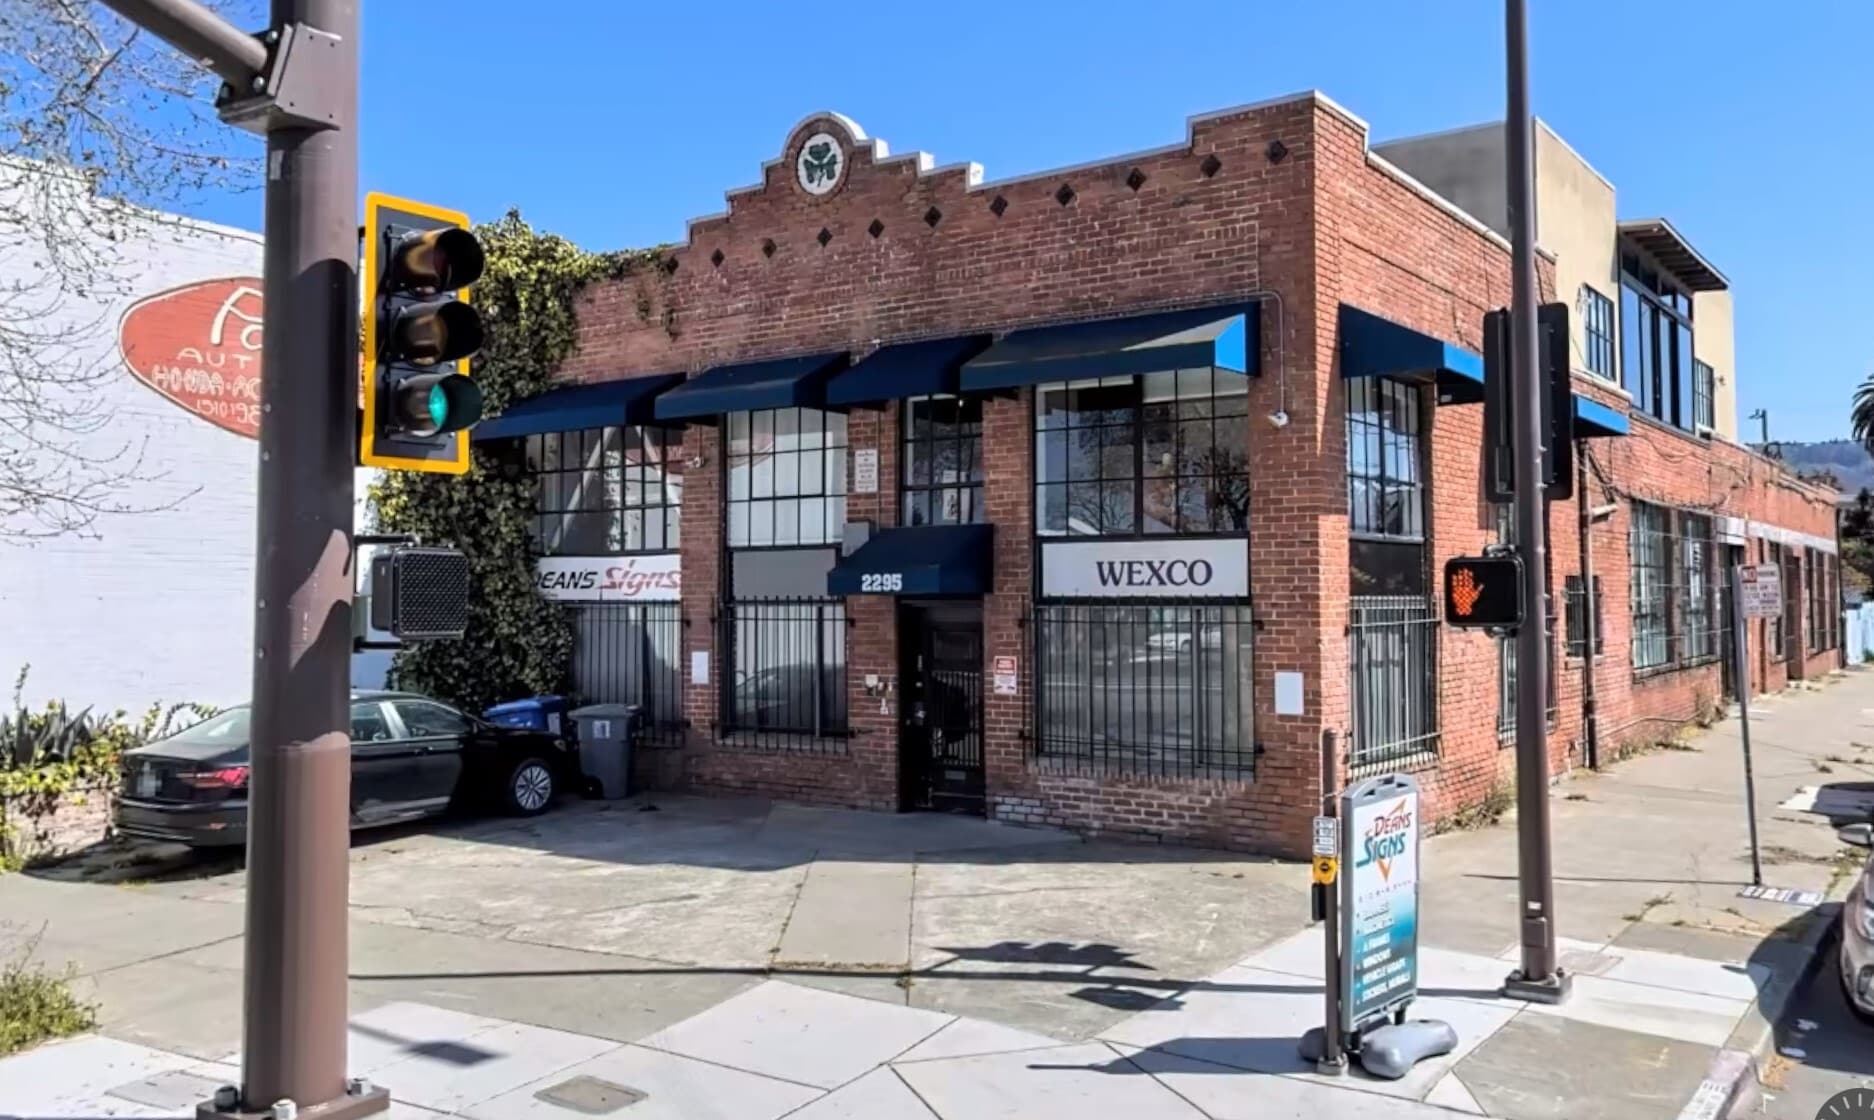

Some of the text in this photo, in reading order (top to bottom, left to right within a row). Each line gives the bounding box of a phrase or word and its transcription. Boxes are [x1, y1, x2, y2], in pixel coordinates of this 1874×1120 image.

[596, 559, 682, 596] Signs
[861, 573, 902, 592] 2295
[1096, 559, 1213, 587] WEXCO
[1374, 812, 1413, 837] DEANS
[1356, 833, 1406, 868] SIGNS
